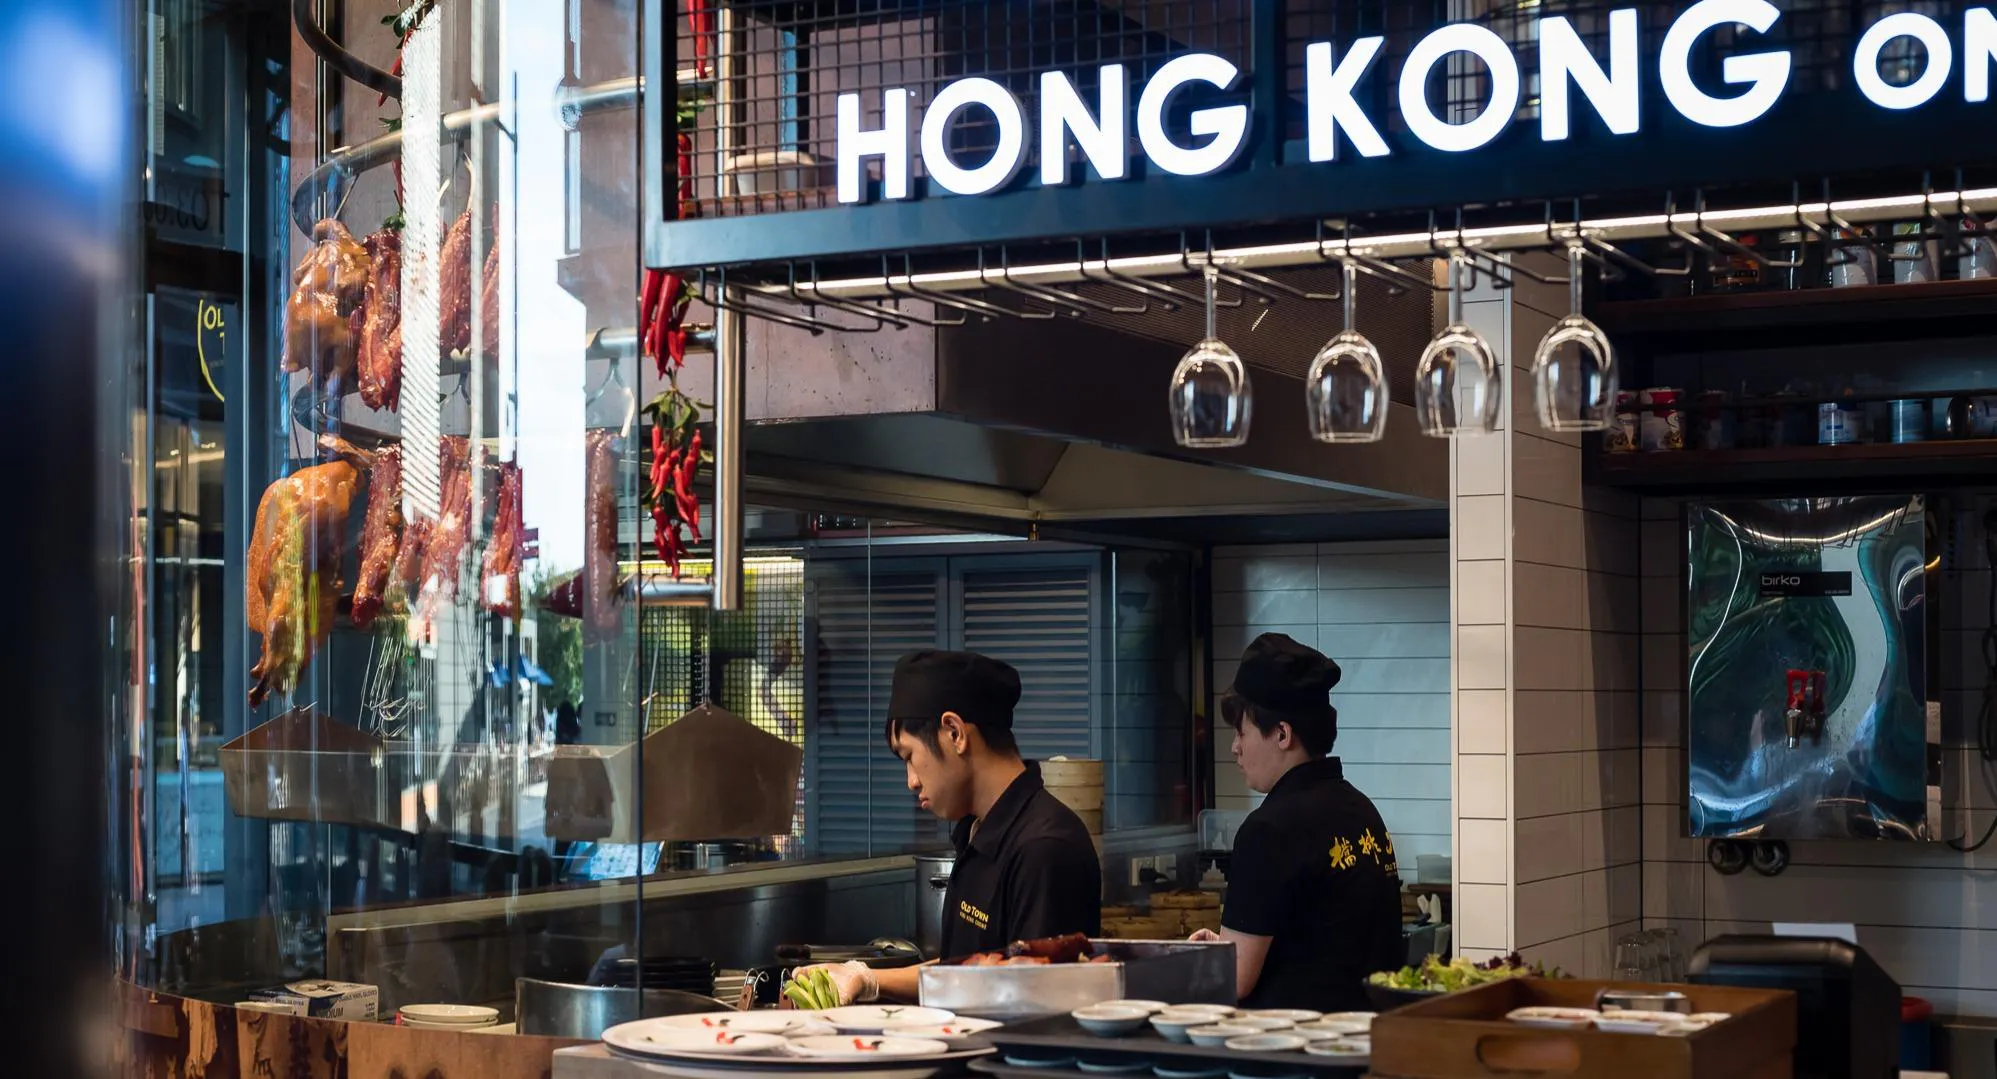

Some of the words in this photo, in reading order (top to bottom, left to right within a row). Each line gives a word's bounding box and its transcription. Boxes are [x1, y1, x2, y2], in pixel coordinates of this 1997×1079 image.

[836, 52, 1249, 203] HONG
[1306, 0, 1792, 163] KONG
[1761, 574, 1800, 585] birko
[960, 900, 971, 913] OLD
[972, 906, 988, 922] TOWN
